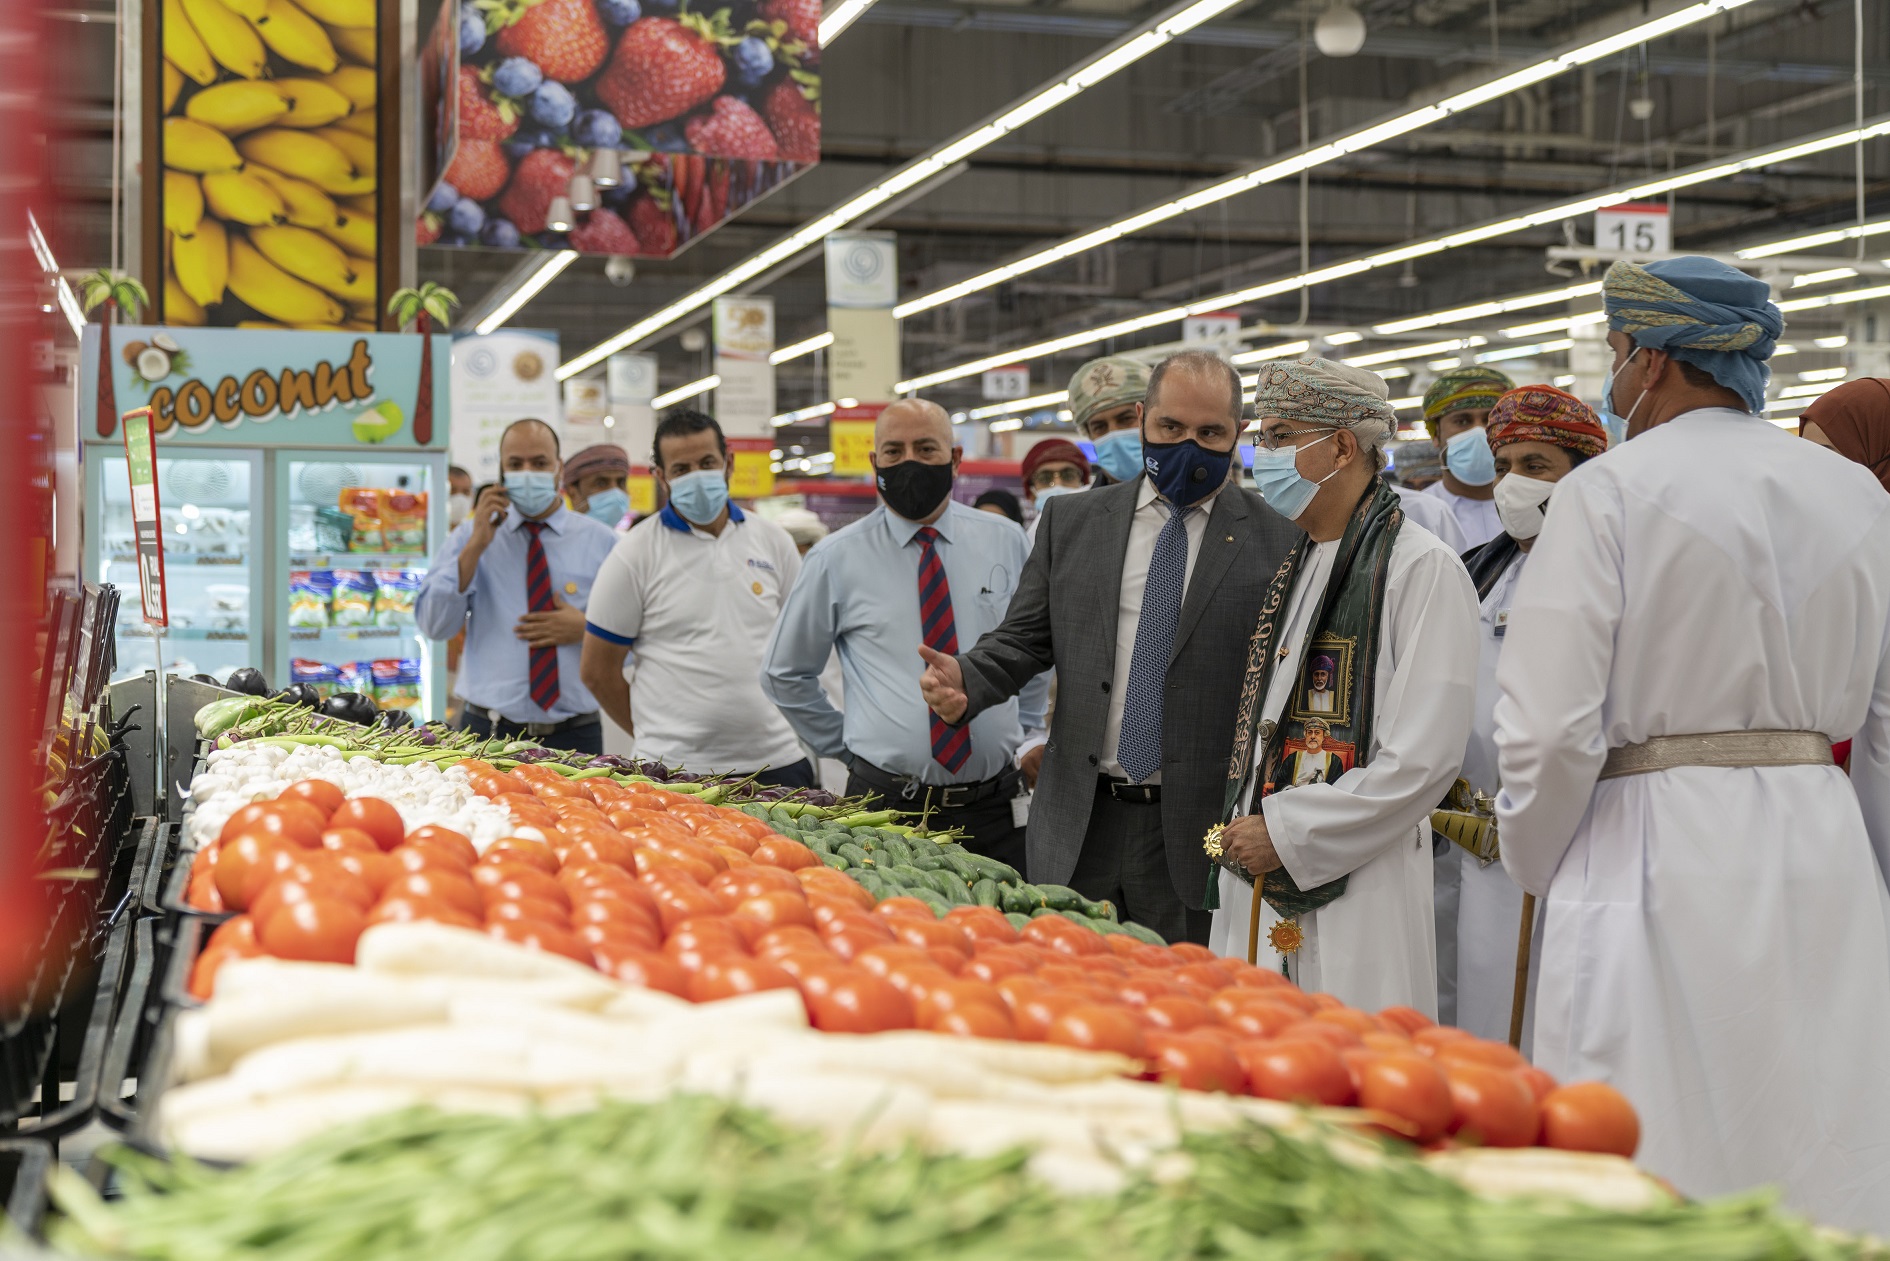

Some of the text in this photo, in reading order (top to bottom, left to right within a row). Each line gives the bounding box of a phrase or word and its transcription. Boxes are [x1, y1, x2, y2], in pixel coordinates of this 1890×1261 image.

[1610, 220, 1655, 253] 15
[149, 338, 375, 436] coconut
[992, 371, 1021, 395] 13
